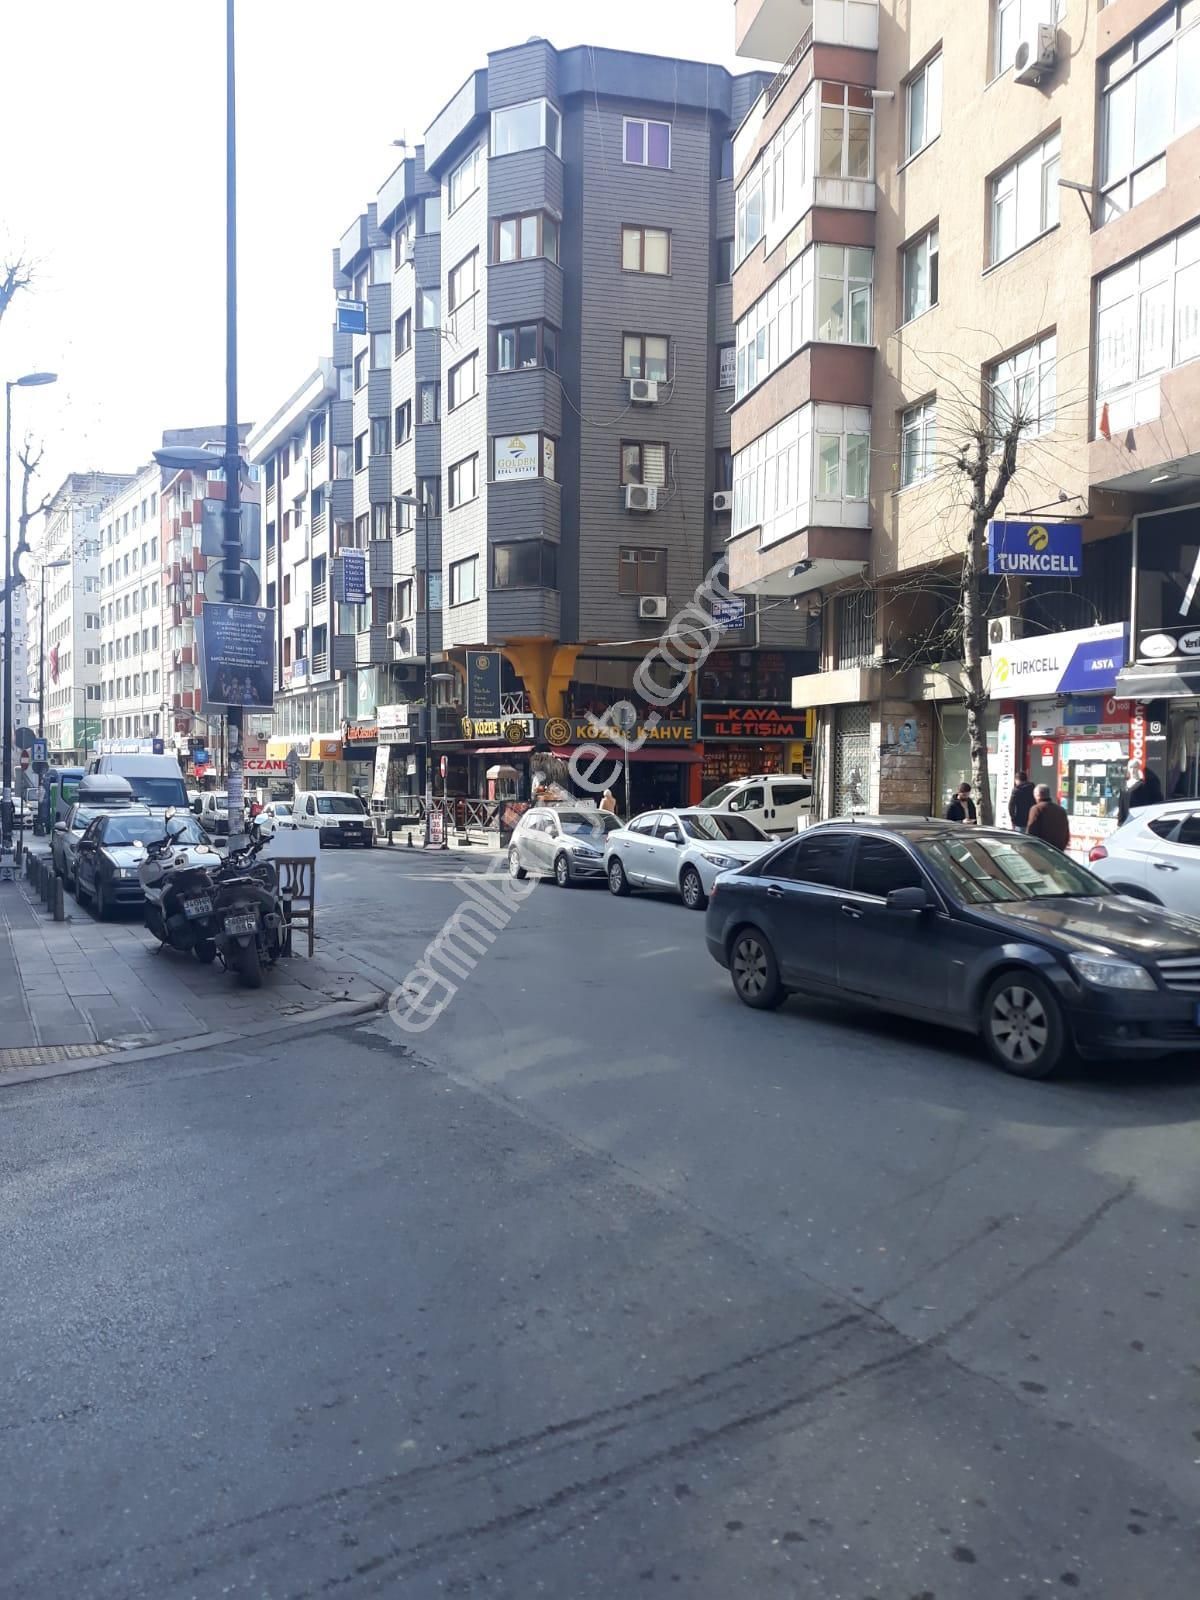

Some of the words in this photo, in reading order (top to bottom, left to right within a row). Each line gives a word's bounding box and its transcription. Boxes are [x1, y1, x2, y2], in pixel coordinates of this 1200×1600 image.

[497, 457, 536, 468] GOLDEN
[997, 552, 1078, 573] TURKCELL
[1010, 657, 1060, 676] TURKCELL
[1091, 658, 1114, 670] ASYA
[728, 709, 781, 721] KAYA
[637, 726, 693, 740] KAHVE
